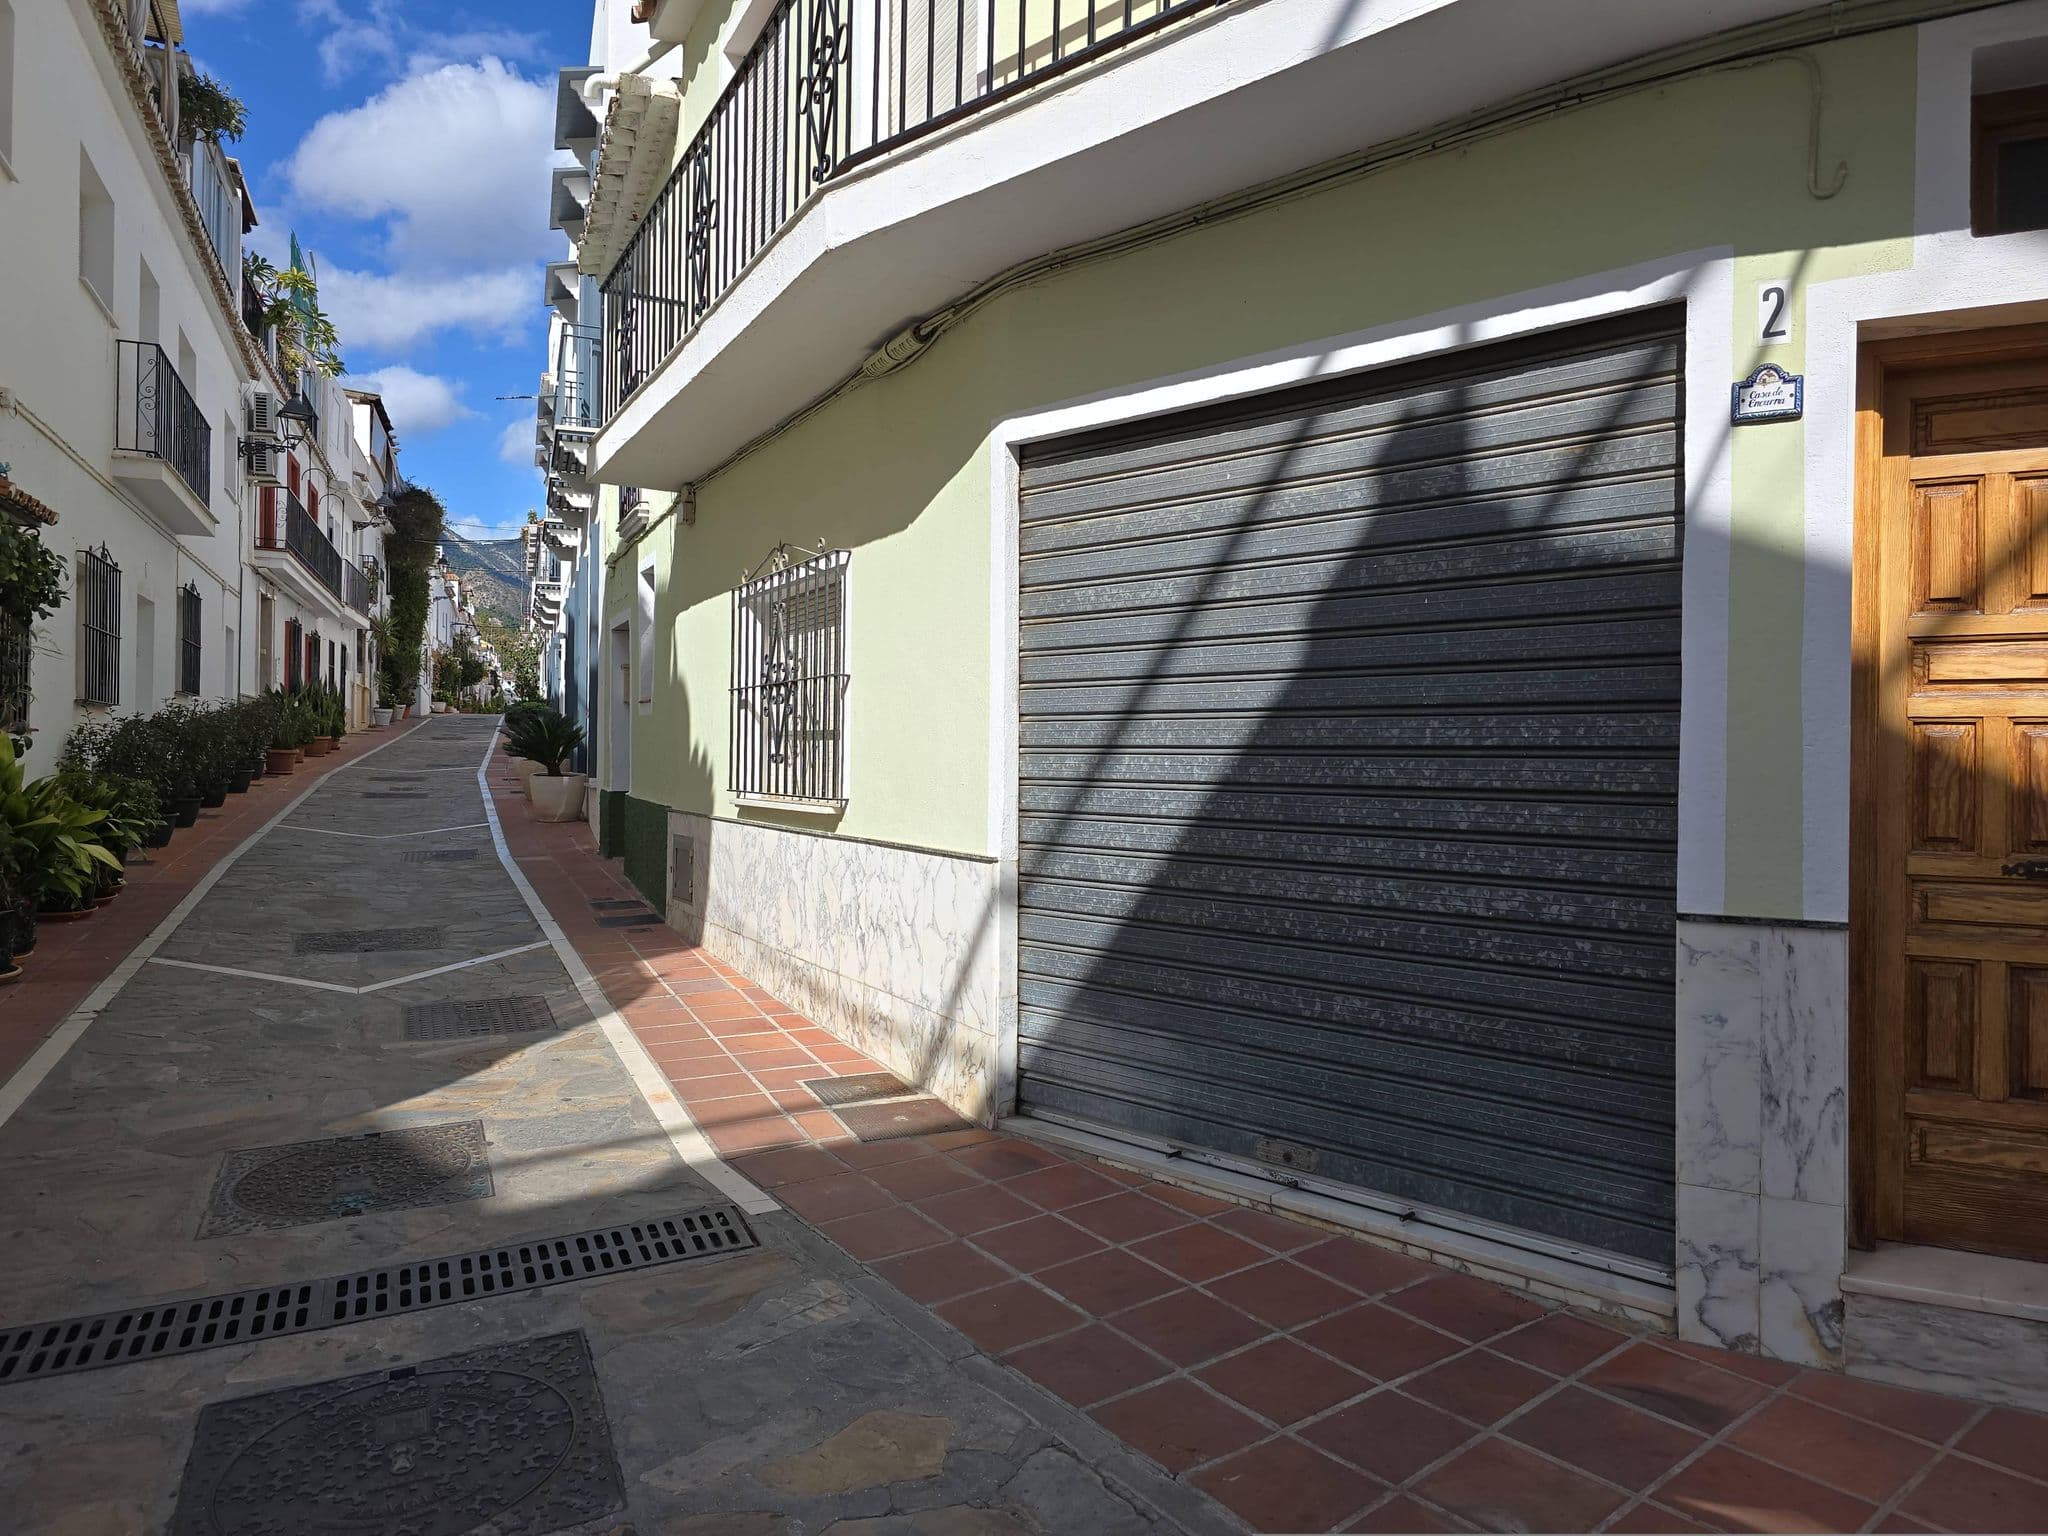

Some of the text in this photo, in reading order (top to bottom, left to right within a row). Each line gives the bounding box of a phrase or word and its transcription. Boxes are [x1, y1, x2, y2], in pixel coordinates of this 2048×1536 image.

[1762, 287, 1786, 339] 2
[1749, 386, 1784, 400] Casa de
